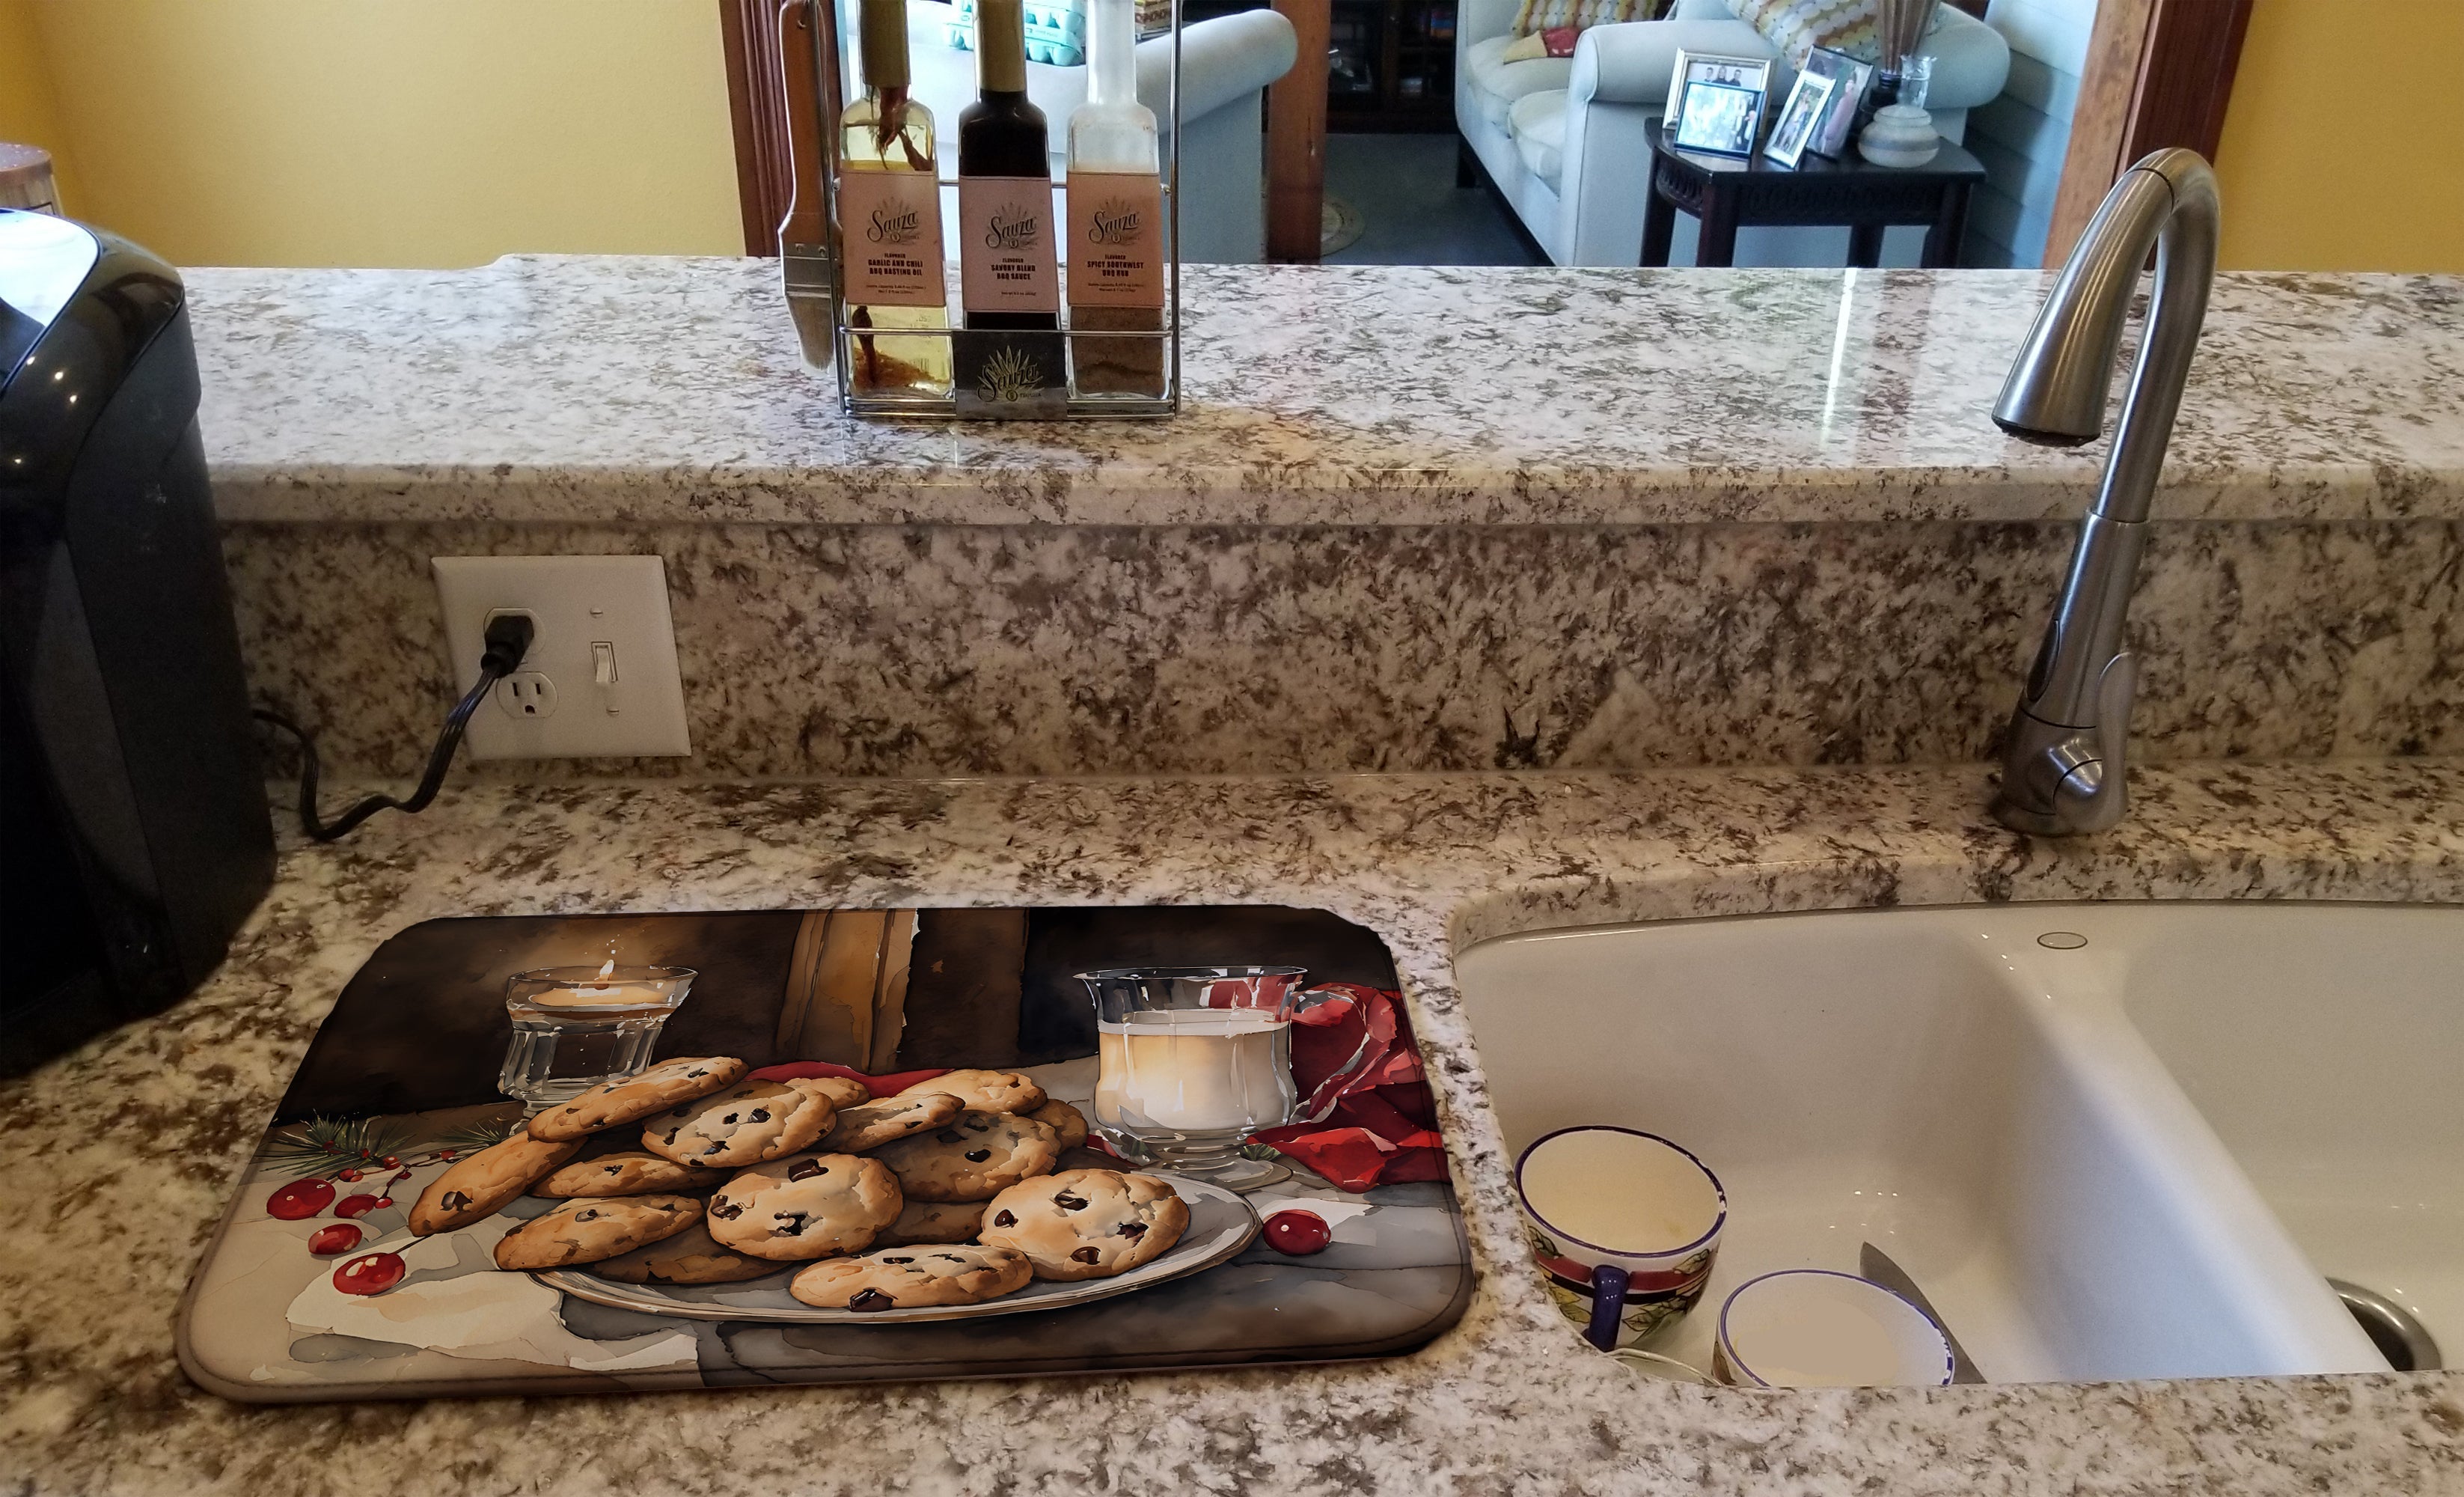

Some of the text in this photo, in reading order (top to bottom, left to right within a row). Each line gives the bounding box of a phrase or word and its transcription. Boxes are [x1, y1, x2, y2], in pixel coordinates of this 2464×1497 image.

[866, 210, 917, 243] Sauza
[985, 216, 1036, 249] Sauza
[1088, 210, 1140, 244] Sauza
[976, 364, 1043, 403] Sauza
